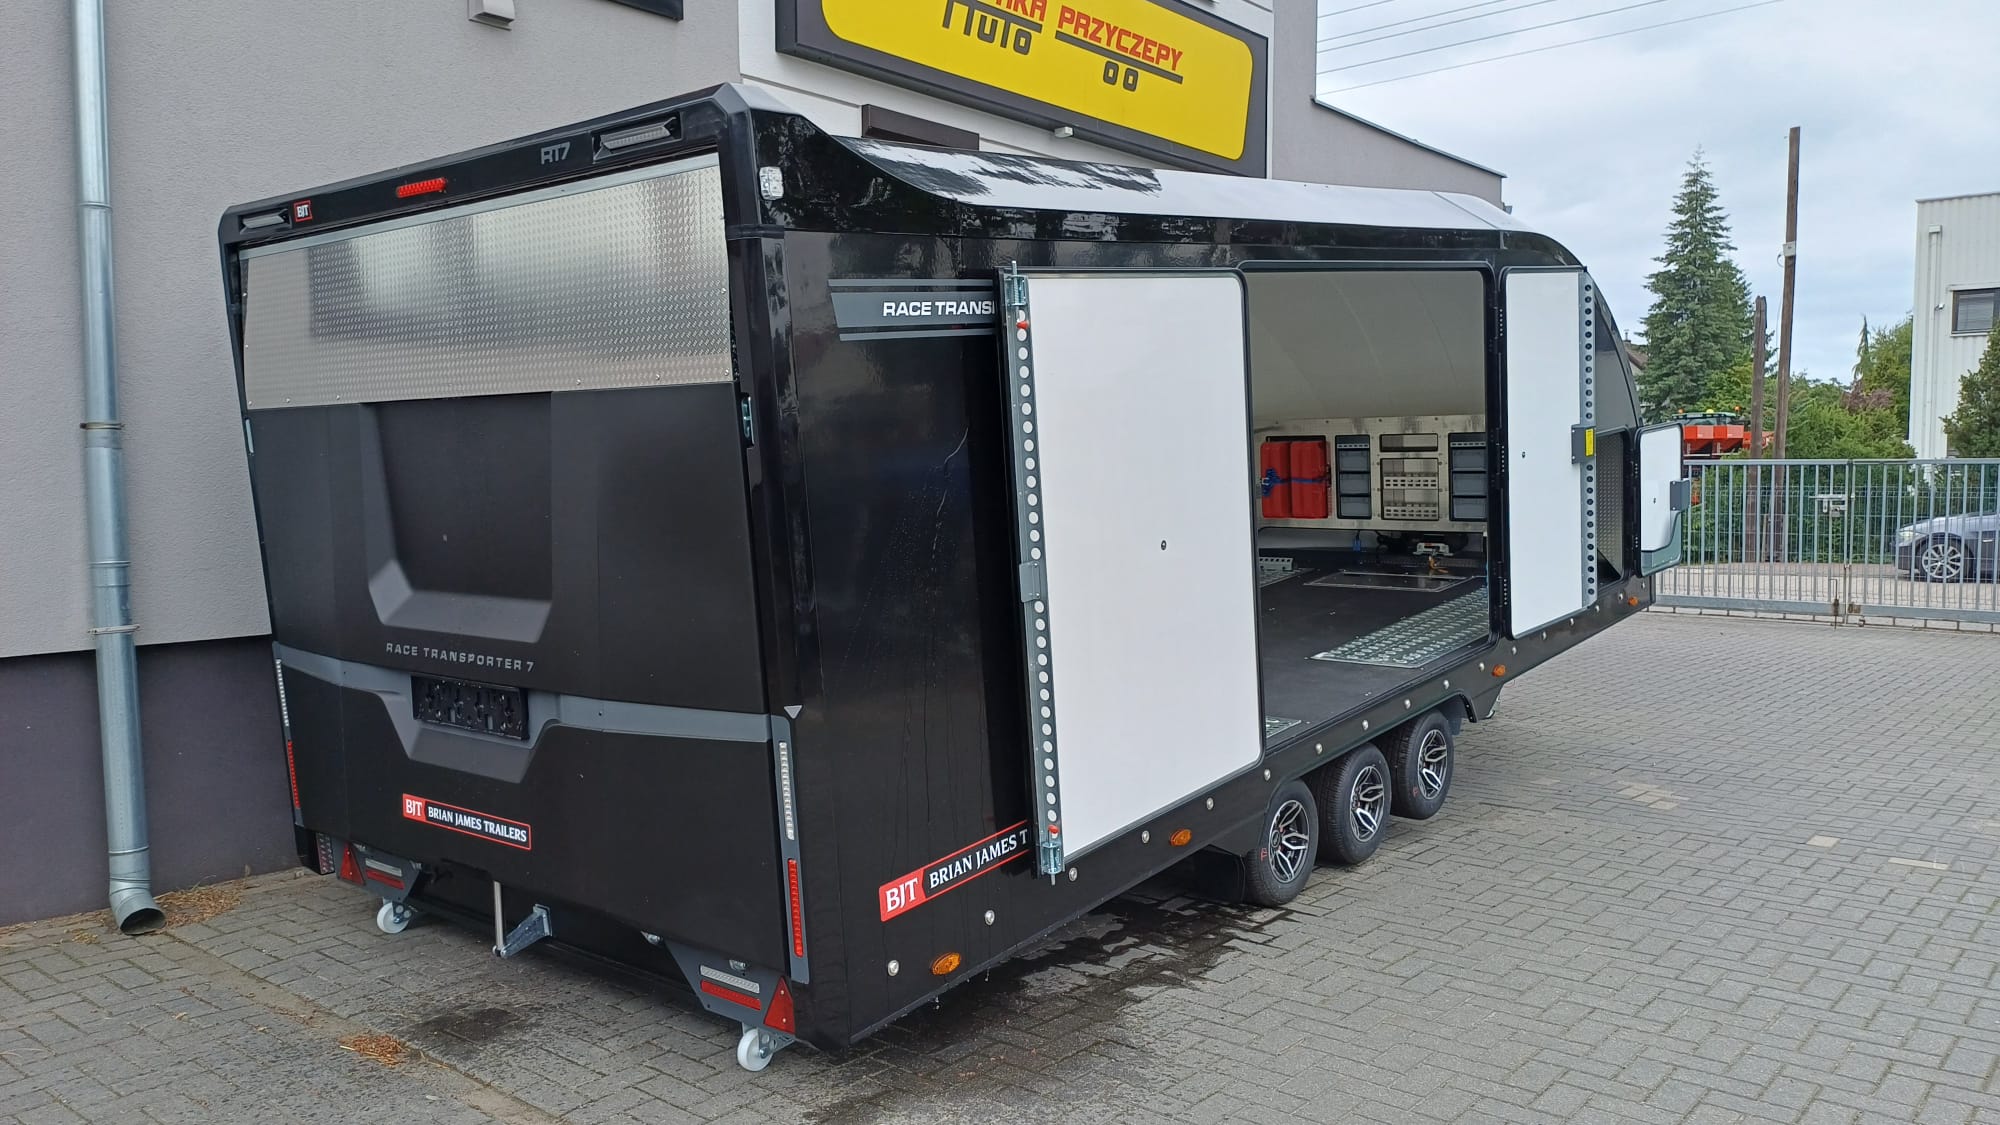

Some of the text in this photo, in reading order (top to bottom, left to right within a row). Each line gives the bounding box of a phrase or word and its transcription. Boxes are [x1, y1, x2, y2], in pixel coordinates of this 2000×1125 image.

[1058, 5, 1183, 71] PRZYCZEPY
[541, 141, 570, 165] RT7
[883, 301, 931, 316] RACE
[386, 642, 535, 673] RACE TRANSPORTER 7
[405, 798, 423, 817] BJT
[428, 806, 527, 842] BRIAN JAMES TRAILERS
[929, 854, 972, 889] BRIAN
[975, 833, 1018, 869] JAMES
[885, 877, 918, 913] BJT
